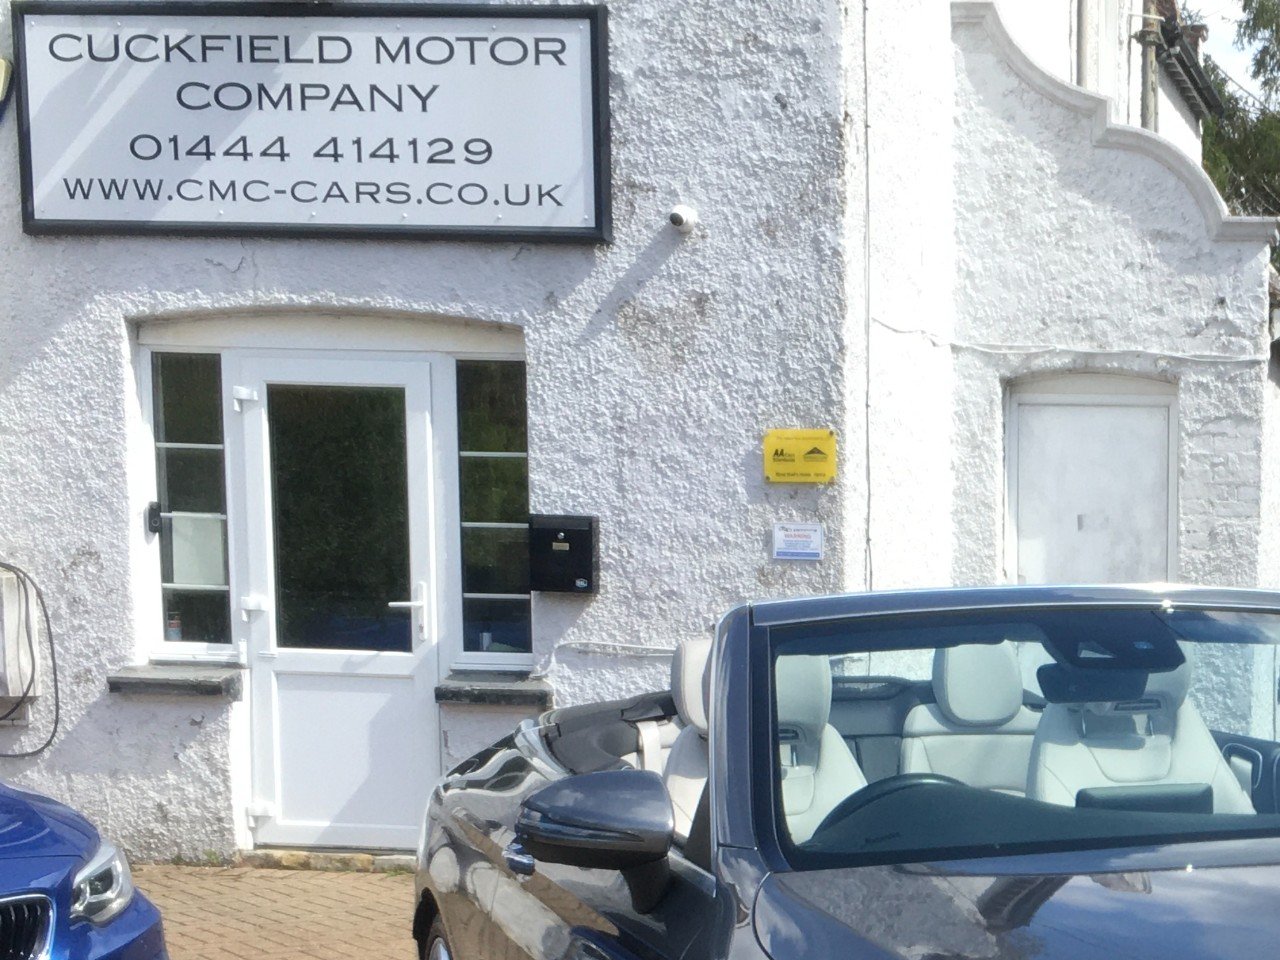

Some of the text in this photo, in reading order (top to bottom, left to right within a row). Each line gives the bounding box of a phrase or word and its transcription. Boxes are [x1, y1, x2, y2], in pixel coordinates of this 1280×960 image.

[48, 33, 567, 67] CUCKFIELD MOTOR
[176, 82, 439, 113] COMPANY
[129, 134, 494, 166] 01444 414129
[63, 178, 563, 207] WWW.CMC-CARS.CO.UK
